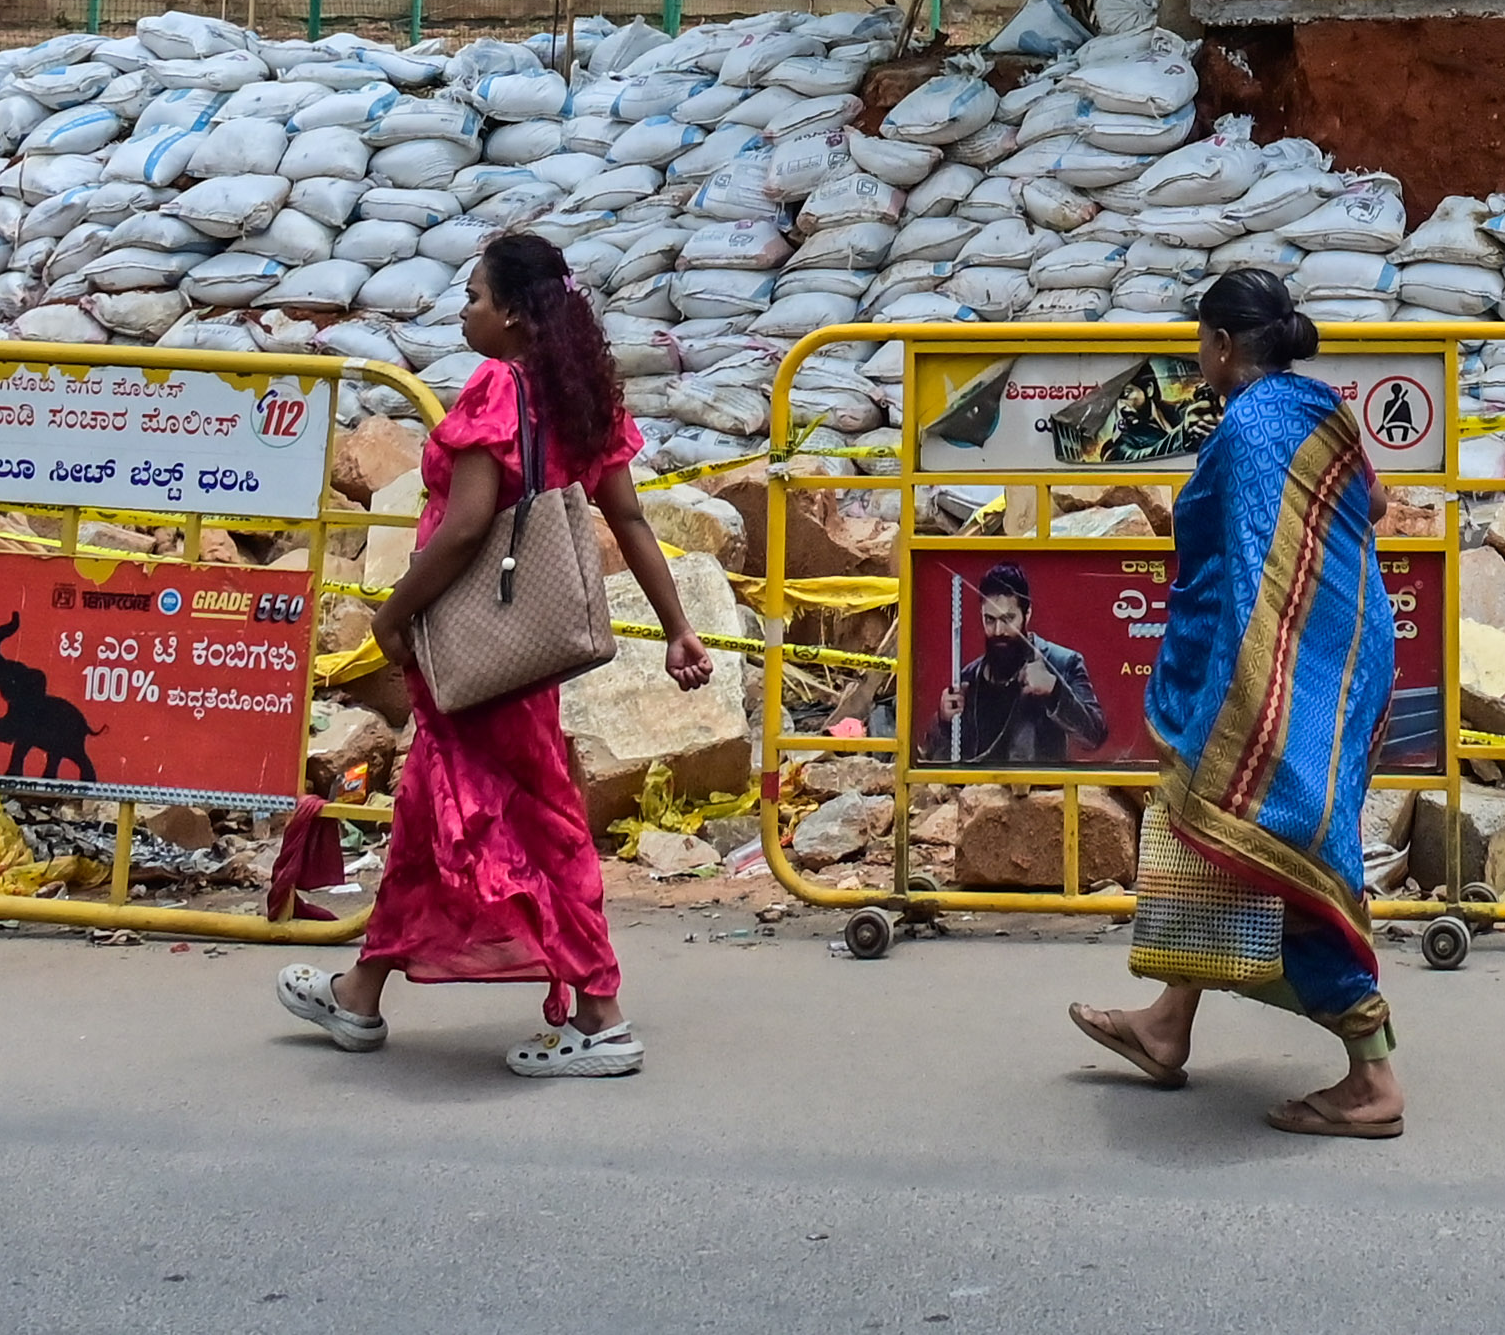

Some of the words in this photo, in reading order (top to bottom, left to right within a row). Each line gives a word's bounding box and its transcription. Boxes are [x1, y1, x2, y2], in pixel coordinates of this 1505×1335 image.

[65, 374, 103, 395] ನಗರ
[112, 377, 186, 401] ಪೊಲೀಸ್
[48, 403, 129, 432] ಸಂಚಾರ
[141, 407, 241, 438] ಪೊಲೀಸ್
[260, 398, 306, 437] 112
[49, 457, 116, 485] ಸೀಟ್
[130, 459, 185, 500] ಬೆಲ್ಟ್
[197, 464, 260, 492] ಧರಿಸಿ
[192, 590, 253, 612] GRADE
[255, 593, 304, 623] 550
[59, 631, 83, 658] ಟಿ
[97, 637, 138, 661] ಎಂ
[153, 637, 177, 663] ಟಿ
[192, 637, 298, 671] ಕಂಬಿಗಳು
[1120, 662, 1131, 675] A
[1135, 664, 1152, 675] co
[82, 666, 160, 703] 100%
[167, 687, 294, 719] ಶುದ್ಧತೆಯೊಂದಿಗೆ
